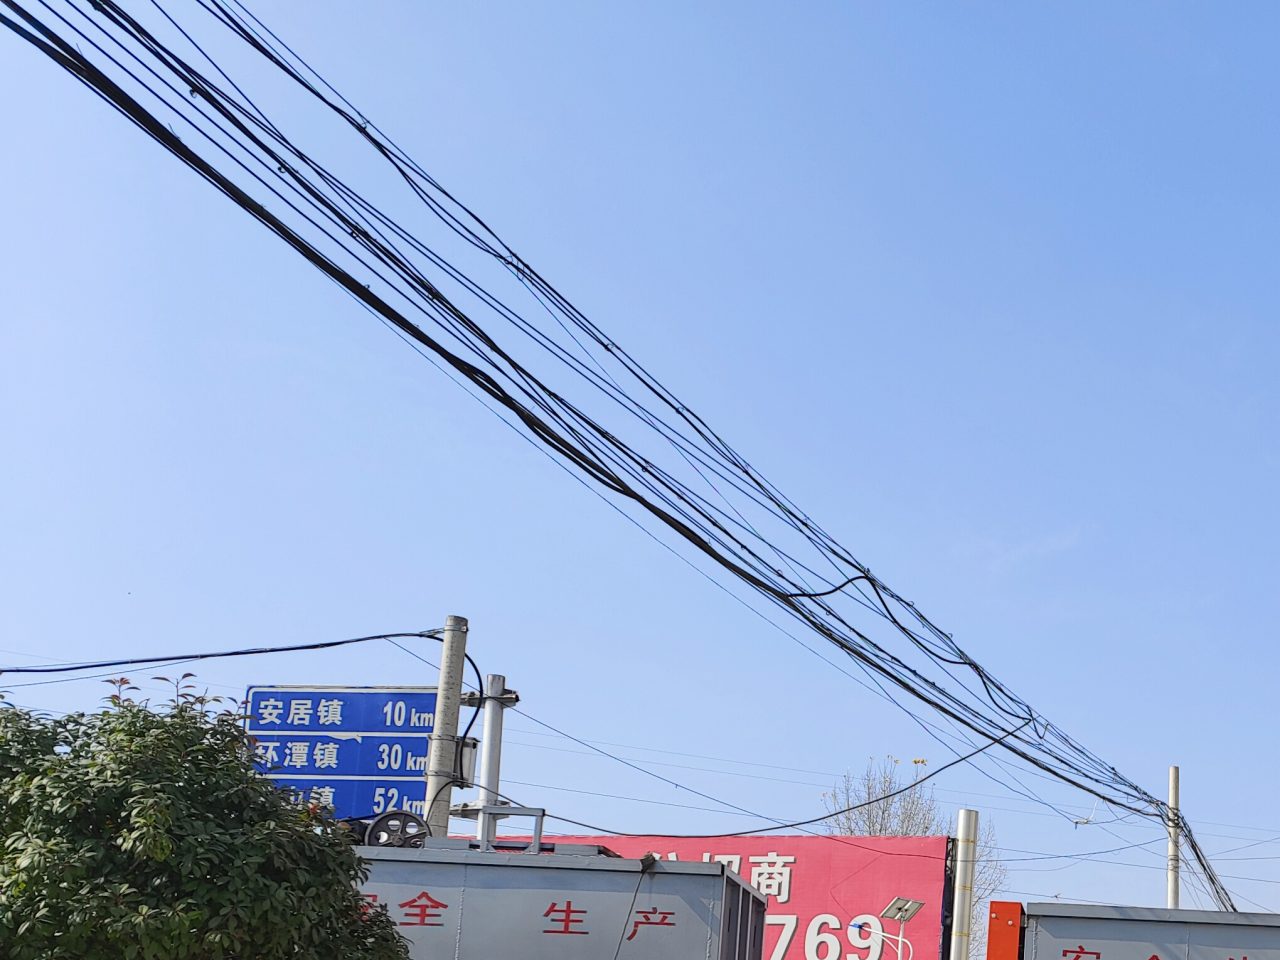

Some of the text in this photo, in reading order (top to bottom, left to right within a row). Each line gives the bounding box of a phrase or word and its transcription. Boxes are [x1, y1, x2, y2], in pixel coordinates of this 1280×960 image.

[258, 698, 434, 727] 安居镇 10 km
[254, 742, 427, 771] 环潭镇 30 km
[373, 787, 399, 814] 52
[402, 795, 425, 815] km
